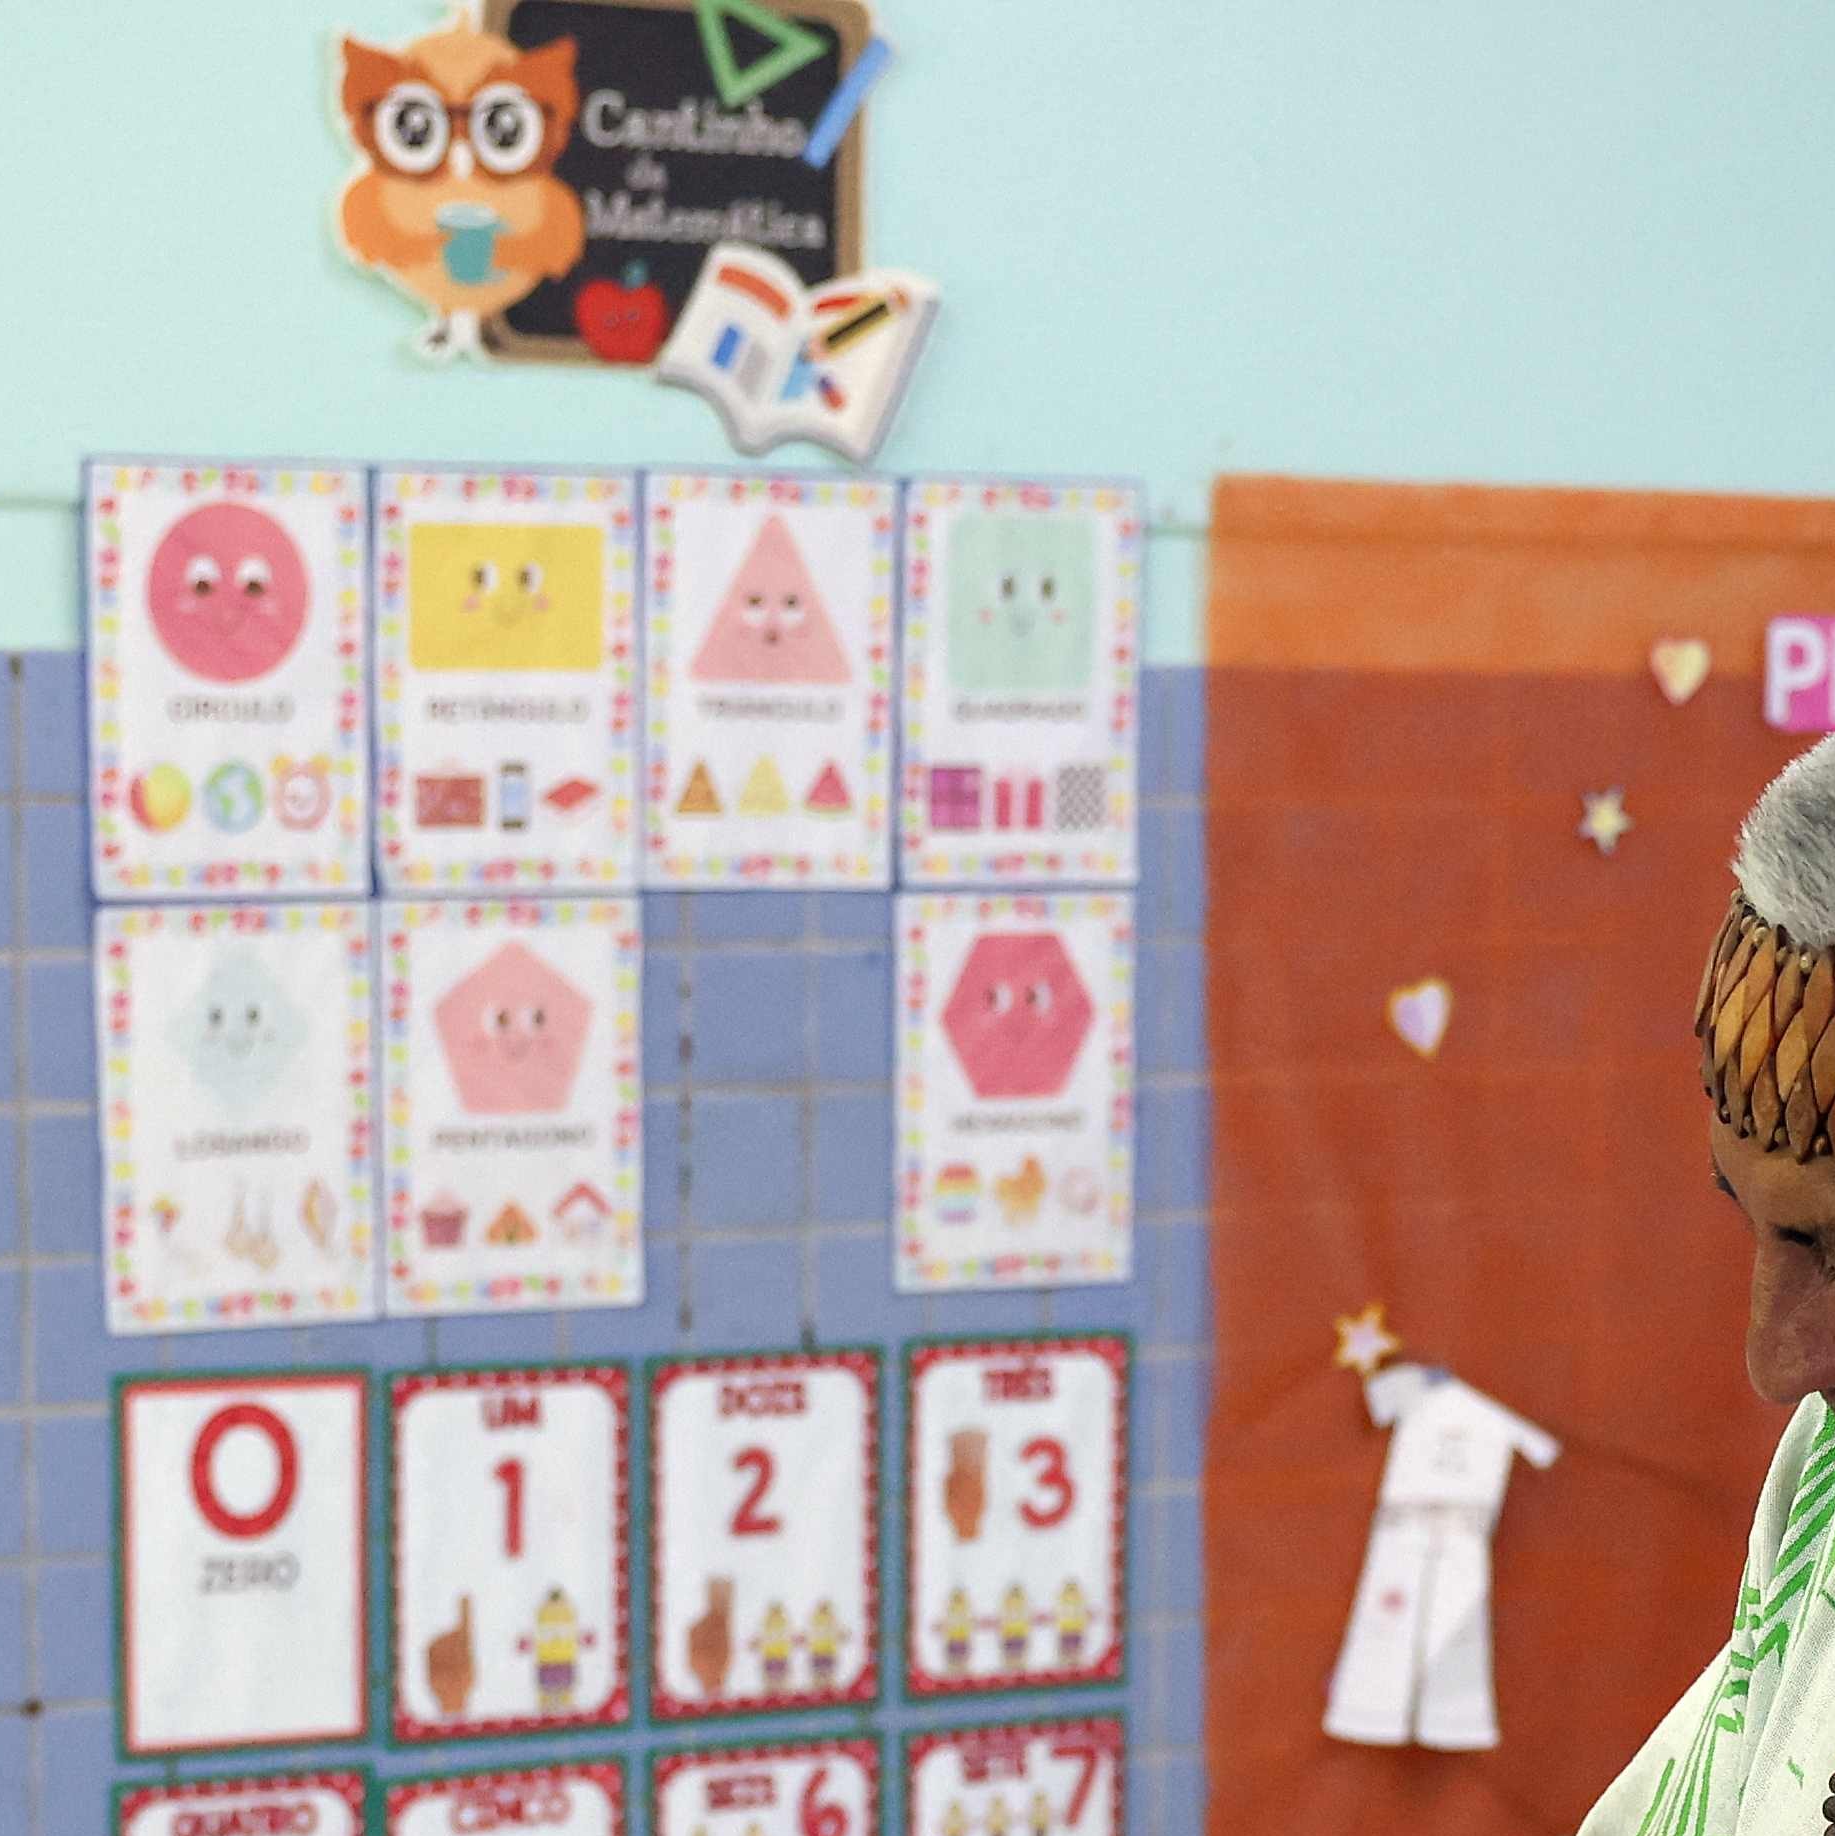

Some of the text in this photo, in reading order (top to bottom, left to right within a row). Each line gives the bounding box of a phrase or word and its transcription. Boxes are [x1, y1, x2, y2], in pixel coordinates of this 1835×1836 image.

[481, 1395, 541, 1431] UM
[493, 1457, 528, 1562] 1
[729, 1446, 782, 1537] 2
[1018, 1435, 1079, 1530] 3
[200, 1549, 300, 1595] ZERO
[1050, 1746, 1100, 1827] 7
